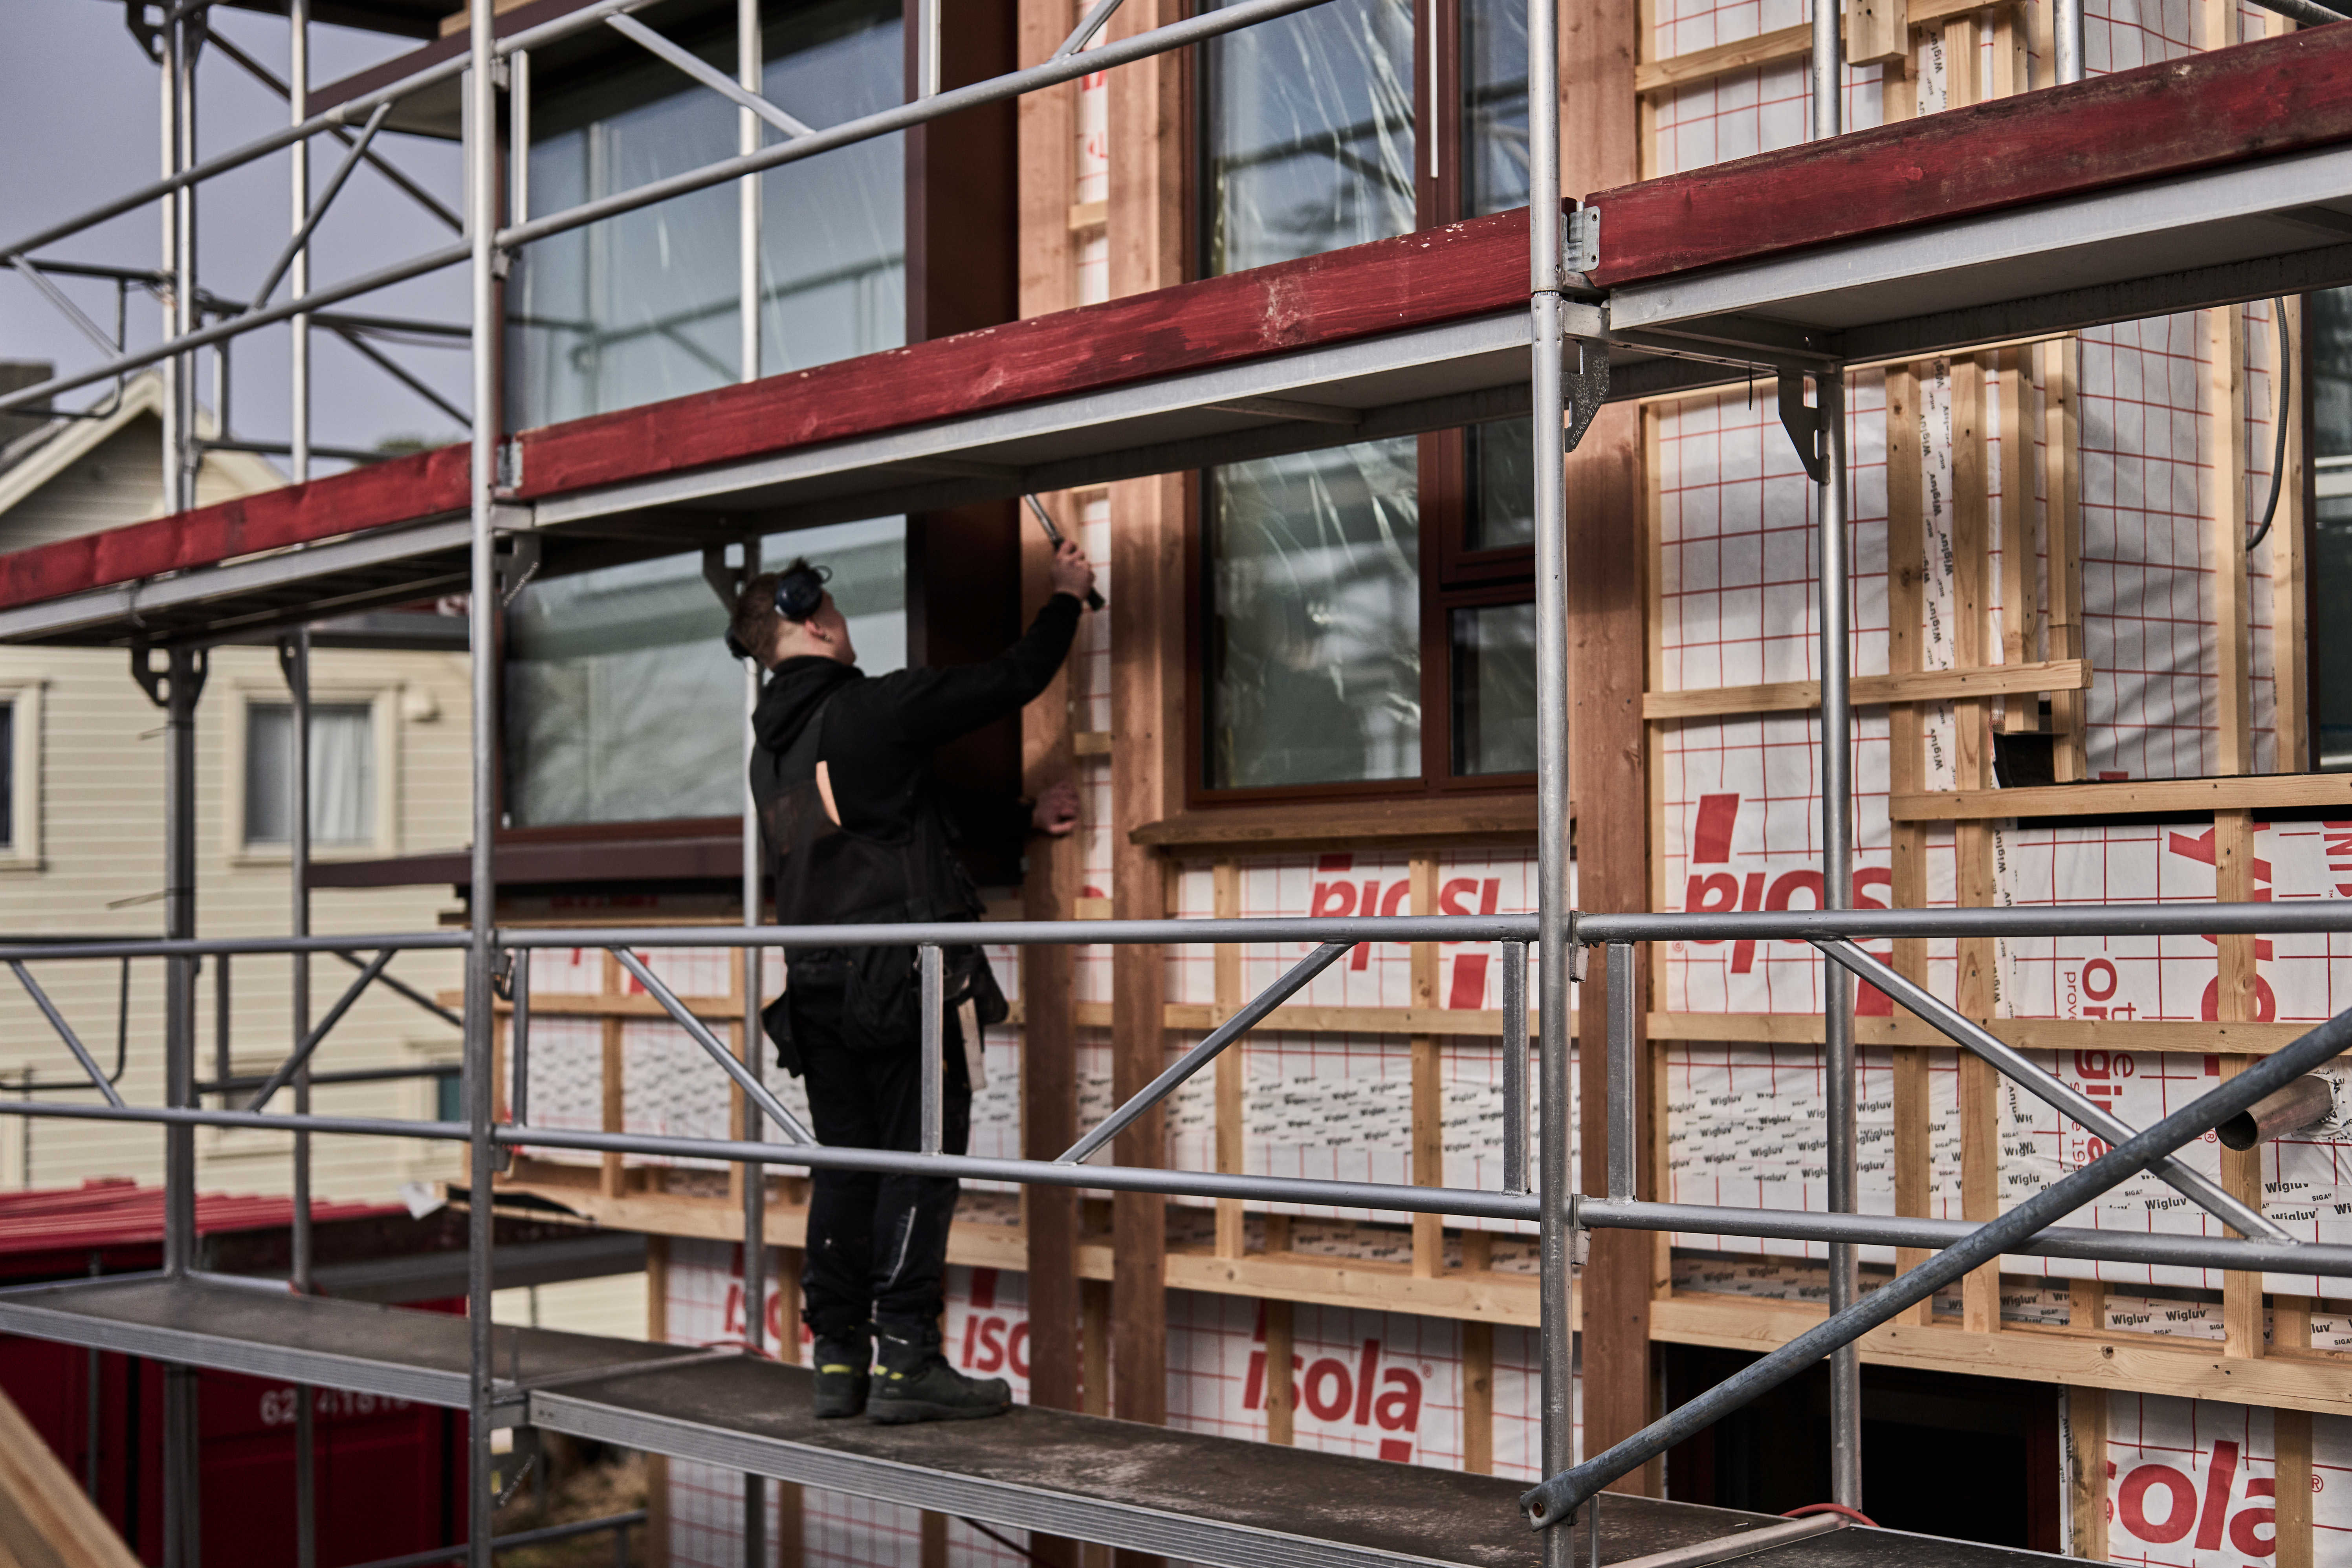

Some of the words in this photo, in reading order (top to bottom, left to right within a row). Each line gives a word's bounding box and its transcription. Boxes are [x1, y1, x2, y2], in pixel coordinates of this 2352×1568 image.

[1929, 473, 1943, 517] Wigluv
[1939, 532, 1953, 576] Wigluv
[1929, 601, 1942, 644] Wigluv
[1930, 728, 1943, 770] Wigluv
[2064, 972, 2077, 1021] prov
[1857, 1101, 1892, 1112] Wigluv
[1807, 1109, 1826, 1119] Wig
[1797, 1140, 1828, 1151] Wiglu
[1856, 1134, 1881, 1145] igluv
[1750, 1145, 1784, 1157] Wigluv
[1802, 1167, 1828, 1178] Wiglu
[2008, 1173, 2040, 1185] Wiglu
[2145, 1198, 2187, 1210] Wigluv
[2112, 1313, 2150, 1326] Wigluv
[2166, 1309, 2206, 1322] Wigluv
[2311, 1323, 2330, 1334] luv
